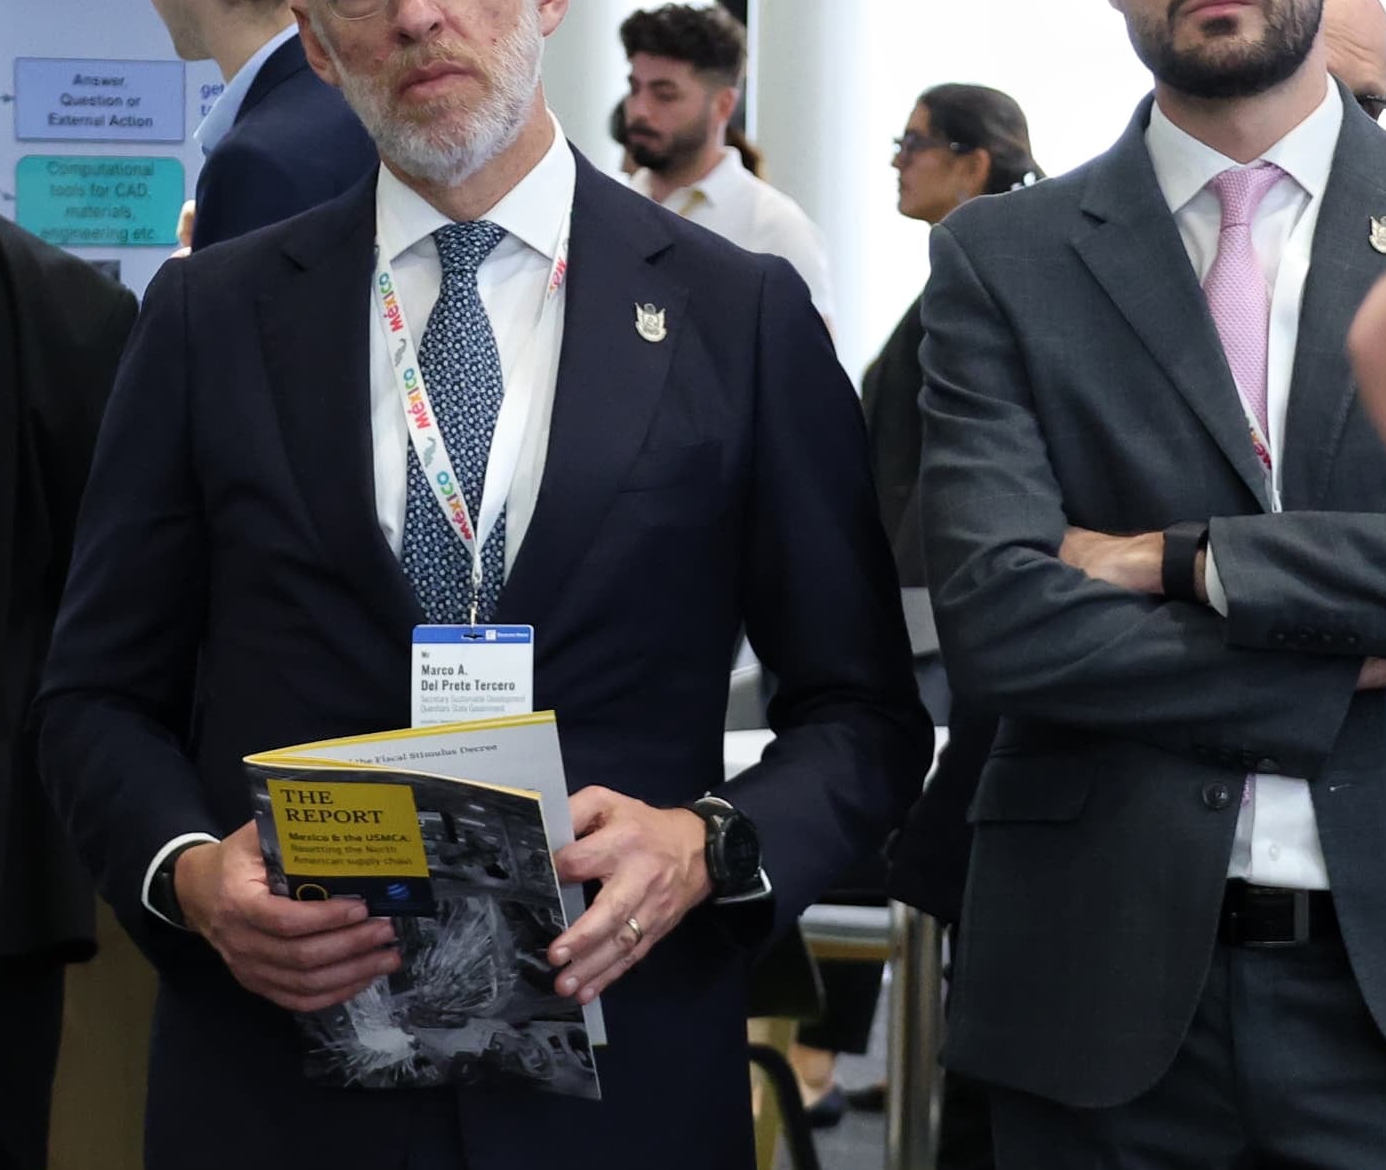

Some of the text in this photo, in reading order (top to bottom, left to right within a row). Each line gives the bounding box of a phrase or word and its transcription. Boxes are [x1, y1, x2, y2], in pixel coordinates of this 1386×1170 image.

[59, 93, 141, 108] Question or
[47, 113, 154, 127] External Action
[46, 161, 155, 178] Computational
[50, 184, 86, 198] tools
[90, 183, 109, 197] for
[40, 228, 129, 243] engineering
[403, 367, 432, 430] México
[421, 664, 468, 676] Marco A.
[421, 679, 515, 691] Del Prete Tercero
[374, 754, 407, 764] Fiscal
[408, 748, 457, 761] Stimulus
[459, 743, 497, 754] Decree
[280, 789, 333, 805] THE
[284, 808, 383, 824] REPORT
[289, 832, 329, 842] Mexico
[343, 833, 362, 842] the
[344, 845, 363, 854] the
[365, 845, 397, 854] North
